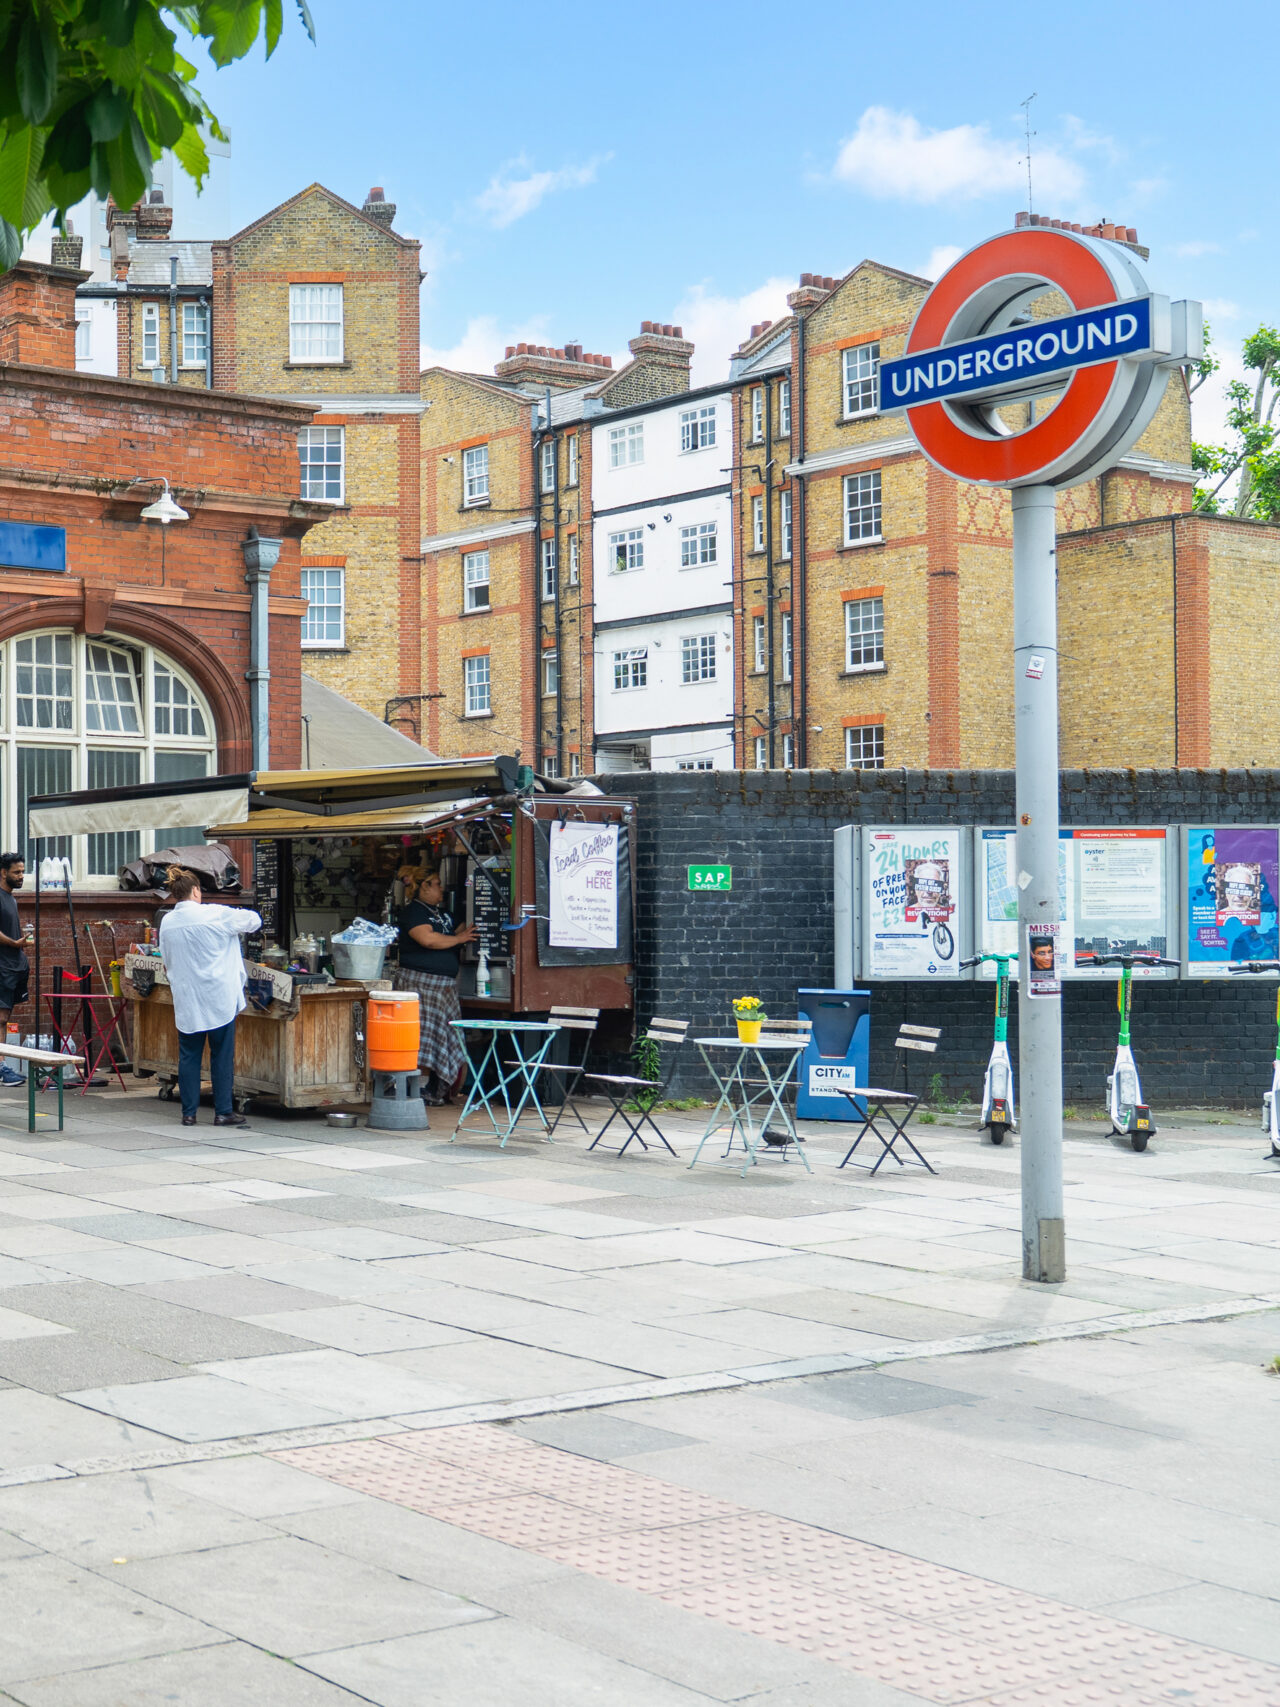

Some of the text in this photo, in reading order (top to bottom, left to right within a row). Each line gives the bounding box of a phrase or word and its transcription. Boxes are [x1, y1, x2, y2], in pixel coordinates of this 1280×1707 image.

[891, 313, 1138, 397] UNDERGROUND
[554, 834, 613, 873] Iced Coffee
[875, 841, 949, 875] 24 HOURS
[586, 876, 612, 890] HERE
[695, 872, 725, 883] SAP
[872, 871, 906, 888] OF BREE
[876, 884, 906, 898] ON YOU
[882, 896, 906, 908] FACE
[135, 959, 162, 971] COLLECT
[251, 967, 276, 982] ORDER
[815, 1067, 843, 1078] CITY
